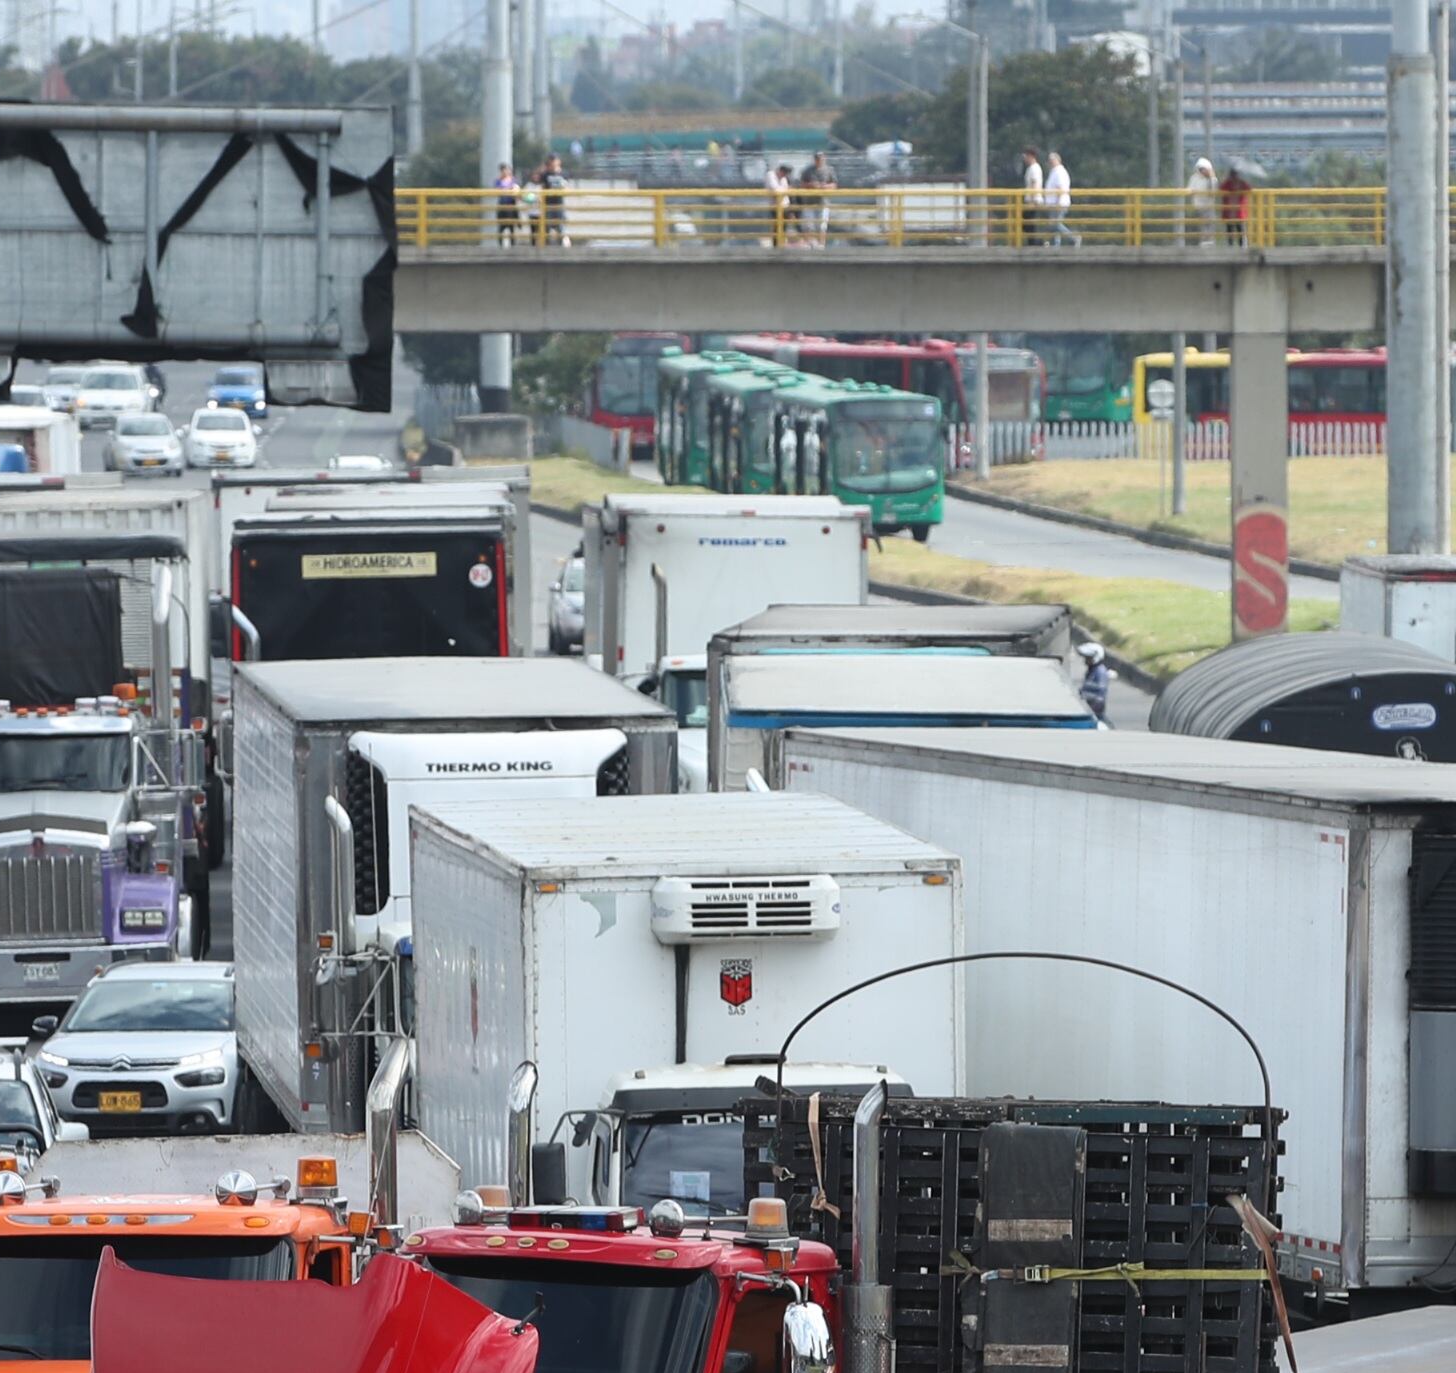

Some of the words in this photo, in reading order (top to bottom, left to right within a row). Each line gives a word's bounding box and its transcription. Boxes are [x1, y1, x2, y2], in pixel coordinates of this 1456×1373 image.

[698, 537, 787, 546] romarco
[323, 556, 414, 570] HIDROAMERICA
[426, 762, 501, 773] THERMO
[507, 761, 553, 772] KING
[706, 893, 754, 903] HWASUNG
[758, 892, 799, 901] THERMO
